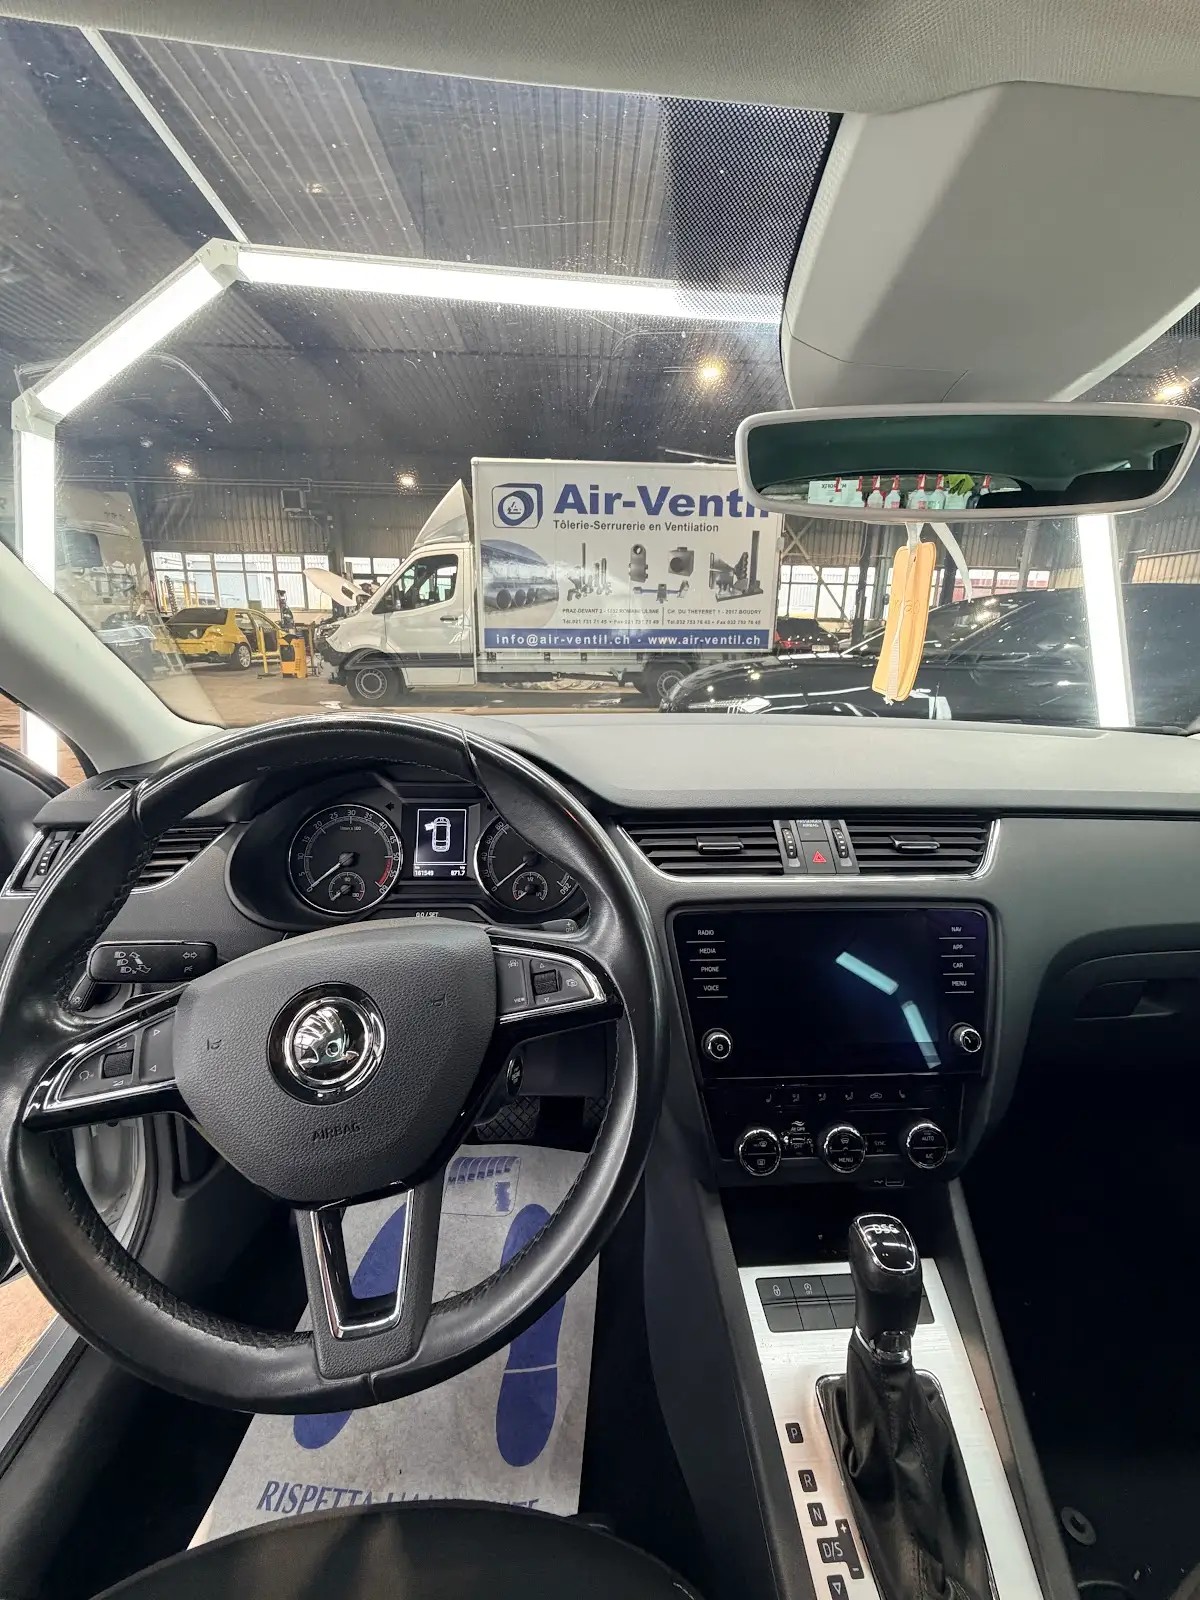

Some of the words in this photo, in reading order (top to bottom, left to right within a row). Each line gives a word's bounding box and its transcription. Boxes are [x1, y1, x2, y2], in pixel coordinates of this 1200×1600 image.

[553, 484, 769, 518] Air-Vent
[553, 520, 645, 531] Tôlerie-Serrurerie
[649, 523, 661, 531] en
[665, 521, 719, 532] Ventilation
[496, 634, 630, 645] info@air-ventil.ch
[648, 635, 760, 645] www.air-ventil.ch
[313, 820, 322, 829] 20
[379, 821, 388, 830] 40
[390, 836, 396, 844] 45
[560, 882, 571, 895] 260
[312, 1122, 360, 1142] AIRBAG
[790, 1428, 798, 1440] P
[804, 1474, 812, 1487] R
[812, 1508, 822, 1521] N
[822, 1542, 844, 1560] D/S
